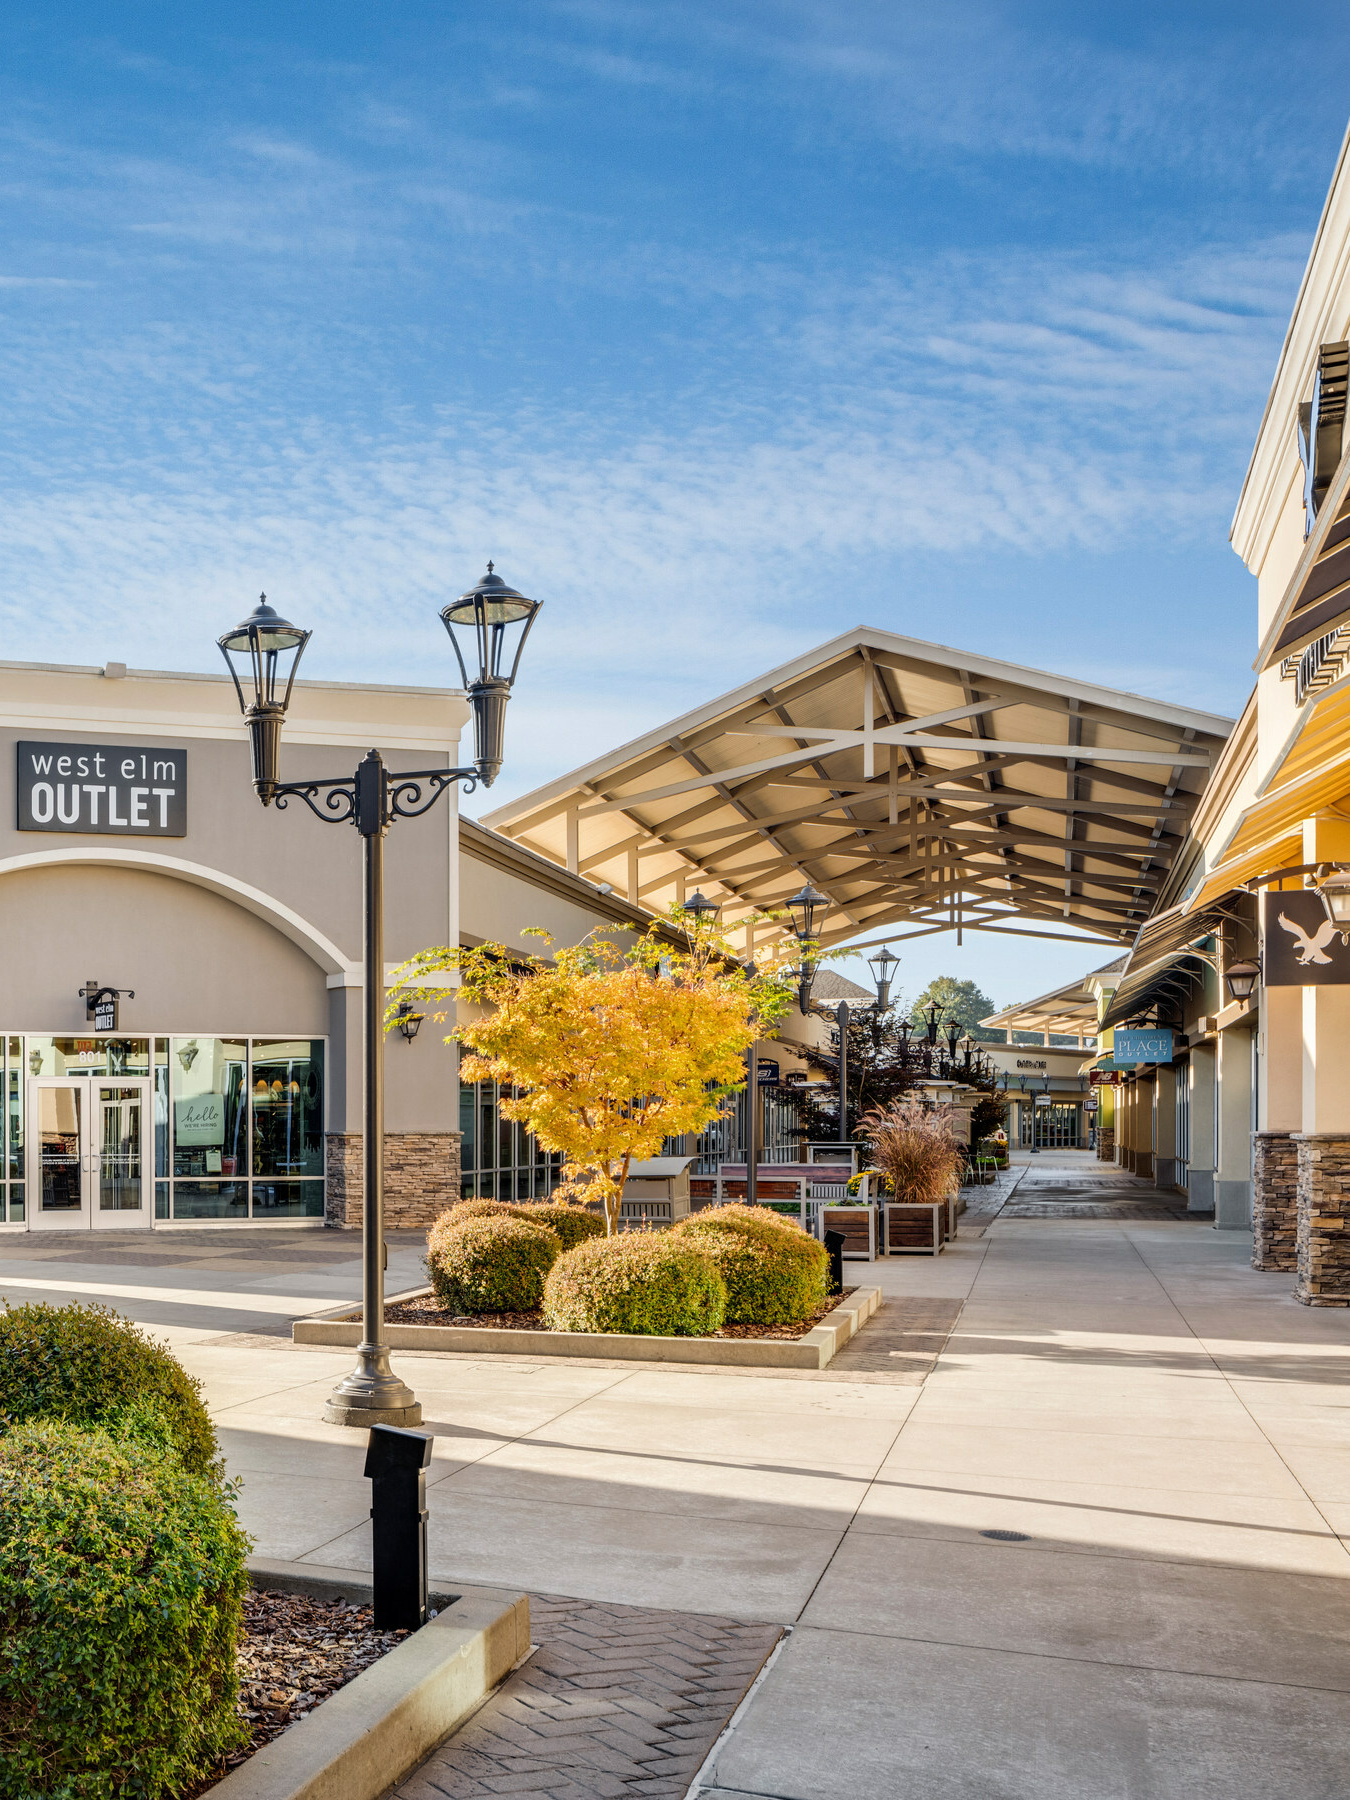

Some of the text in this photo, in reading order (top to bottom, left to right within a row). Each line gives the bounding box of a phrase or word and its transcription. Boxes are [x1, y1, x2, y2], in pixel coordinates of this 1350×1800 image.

[31, 752, 176, 781] west elm
[31, 782, 176, 828] OUTLET
[95, 1003, 114, 1014] west elm
[95, 1014, 114, 1030] OUTLET
[1118, 1040, 1168, 1051] PLACE
[79, 1051, 101, 1064] 801
[181, 1105, 219, 1123] hello
